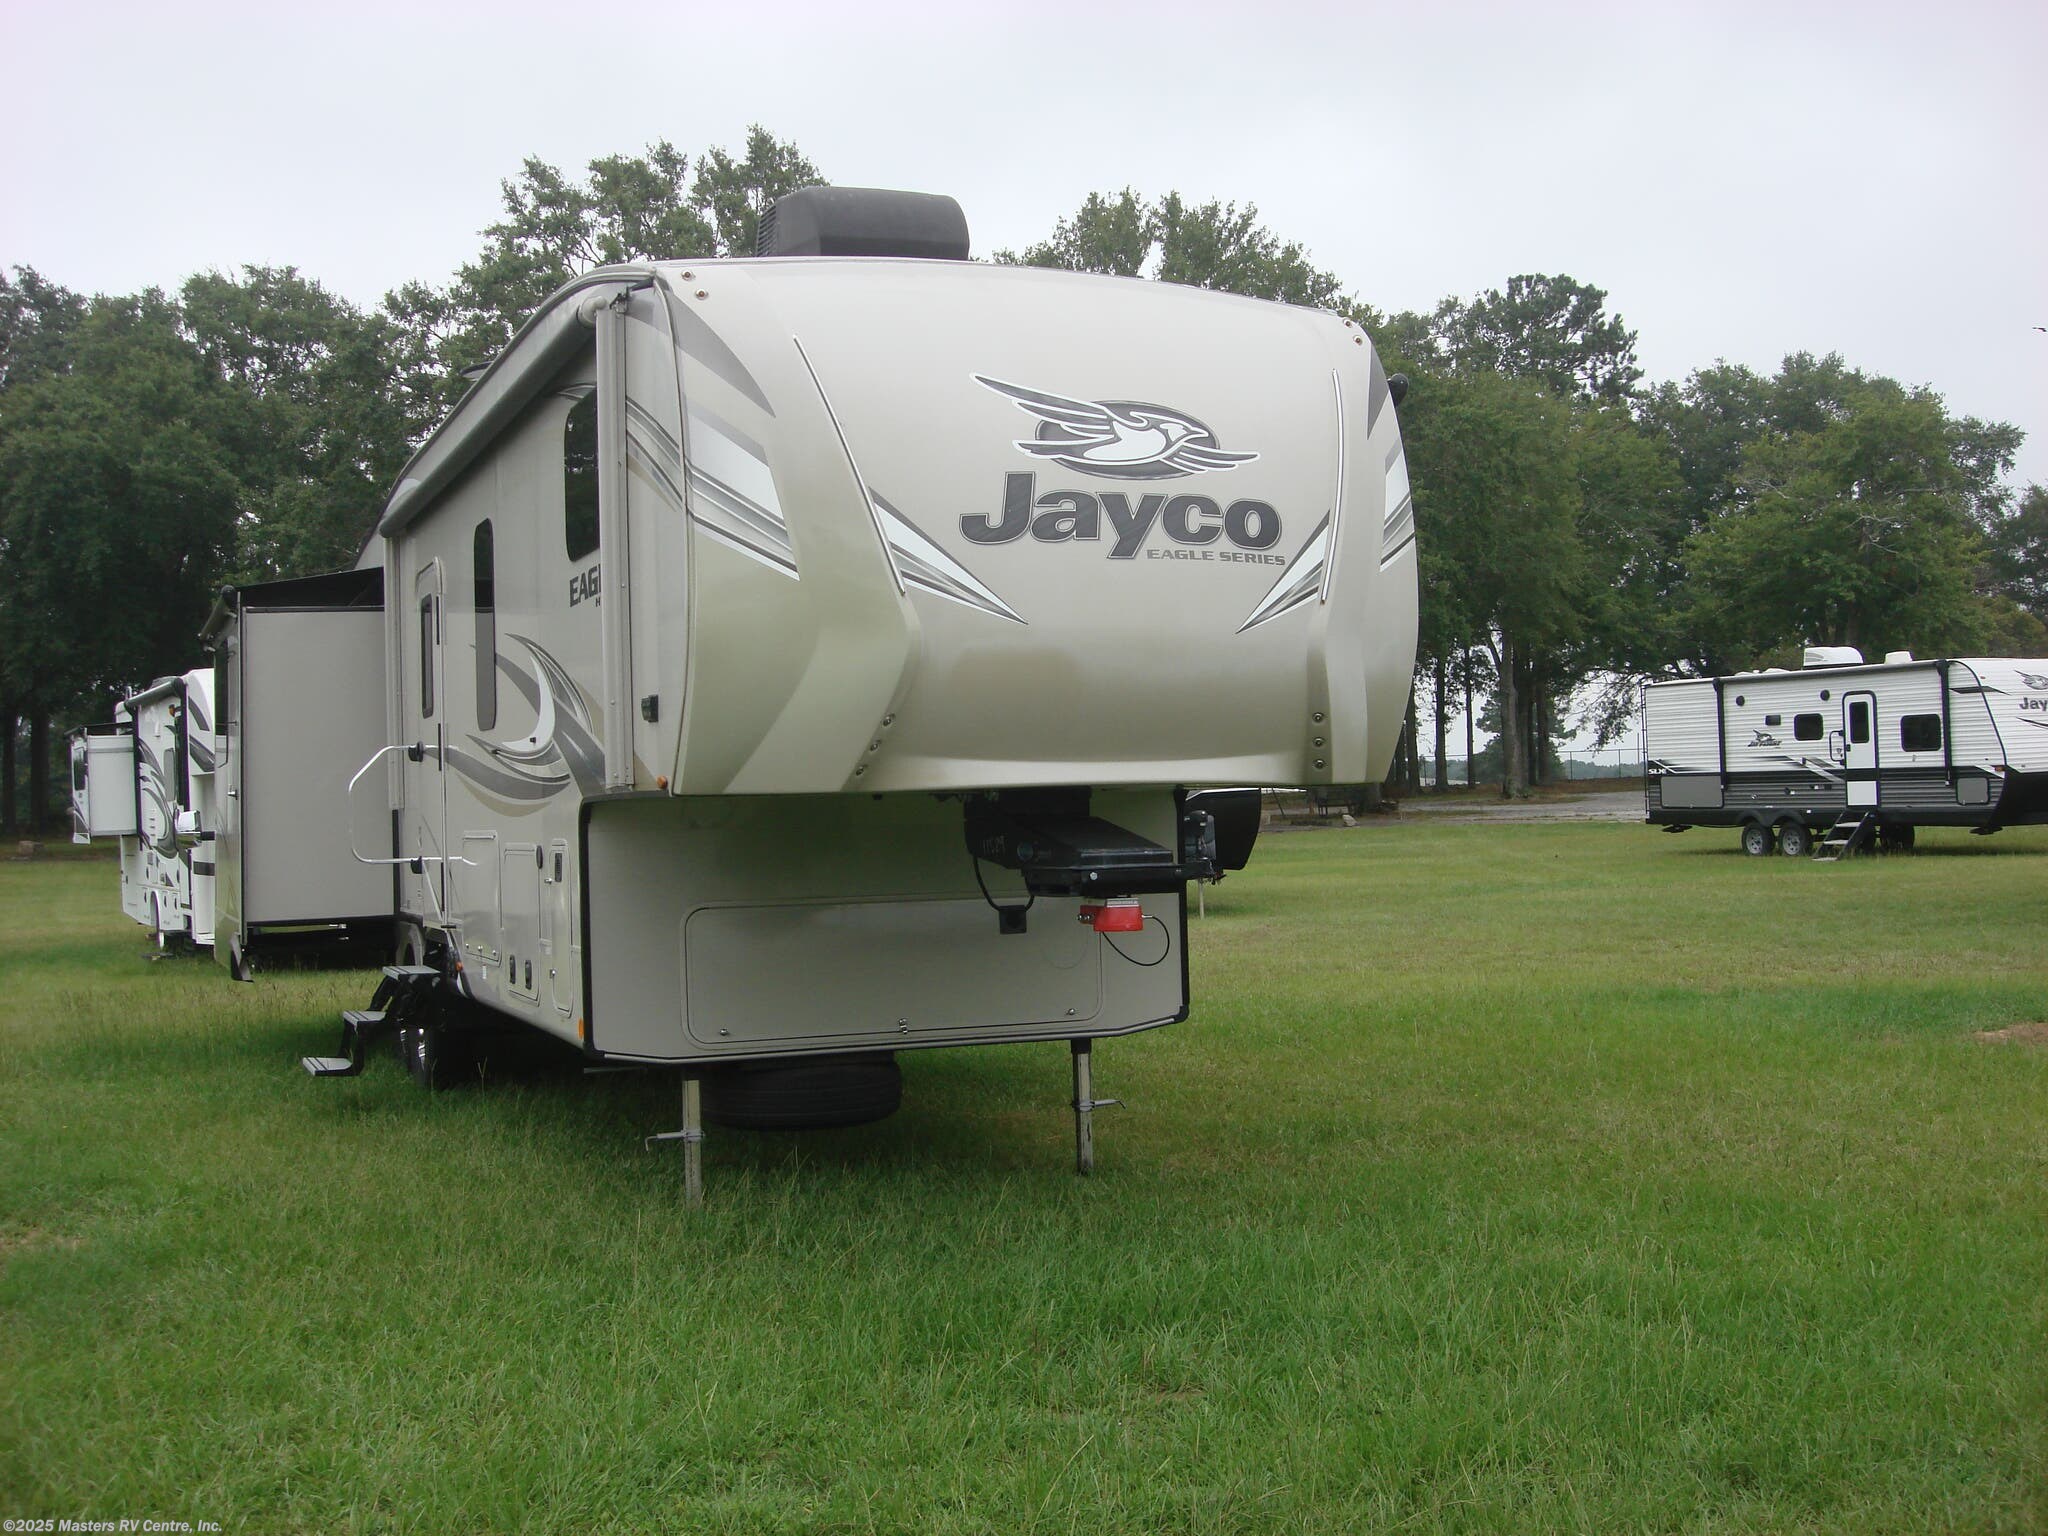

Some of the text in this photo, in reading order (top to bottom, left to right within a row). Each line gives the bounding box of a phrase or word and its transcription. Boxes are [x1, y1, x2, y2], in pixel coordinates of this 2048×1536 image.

[958, 471, 1282, 560] Jayco
[1147, 549, 1285, 565] EAGLE SERIES
